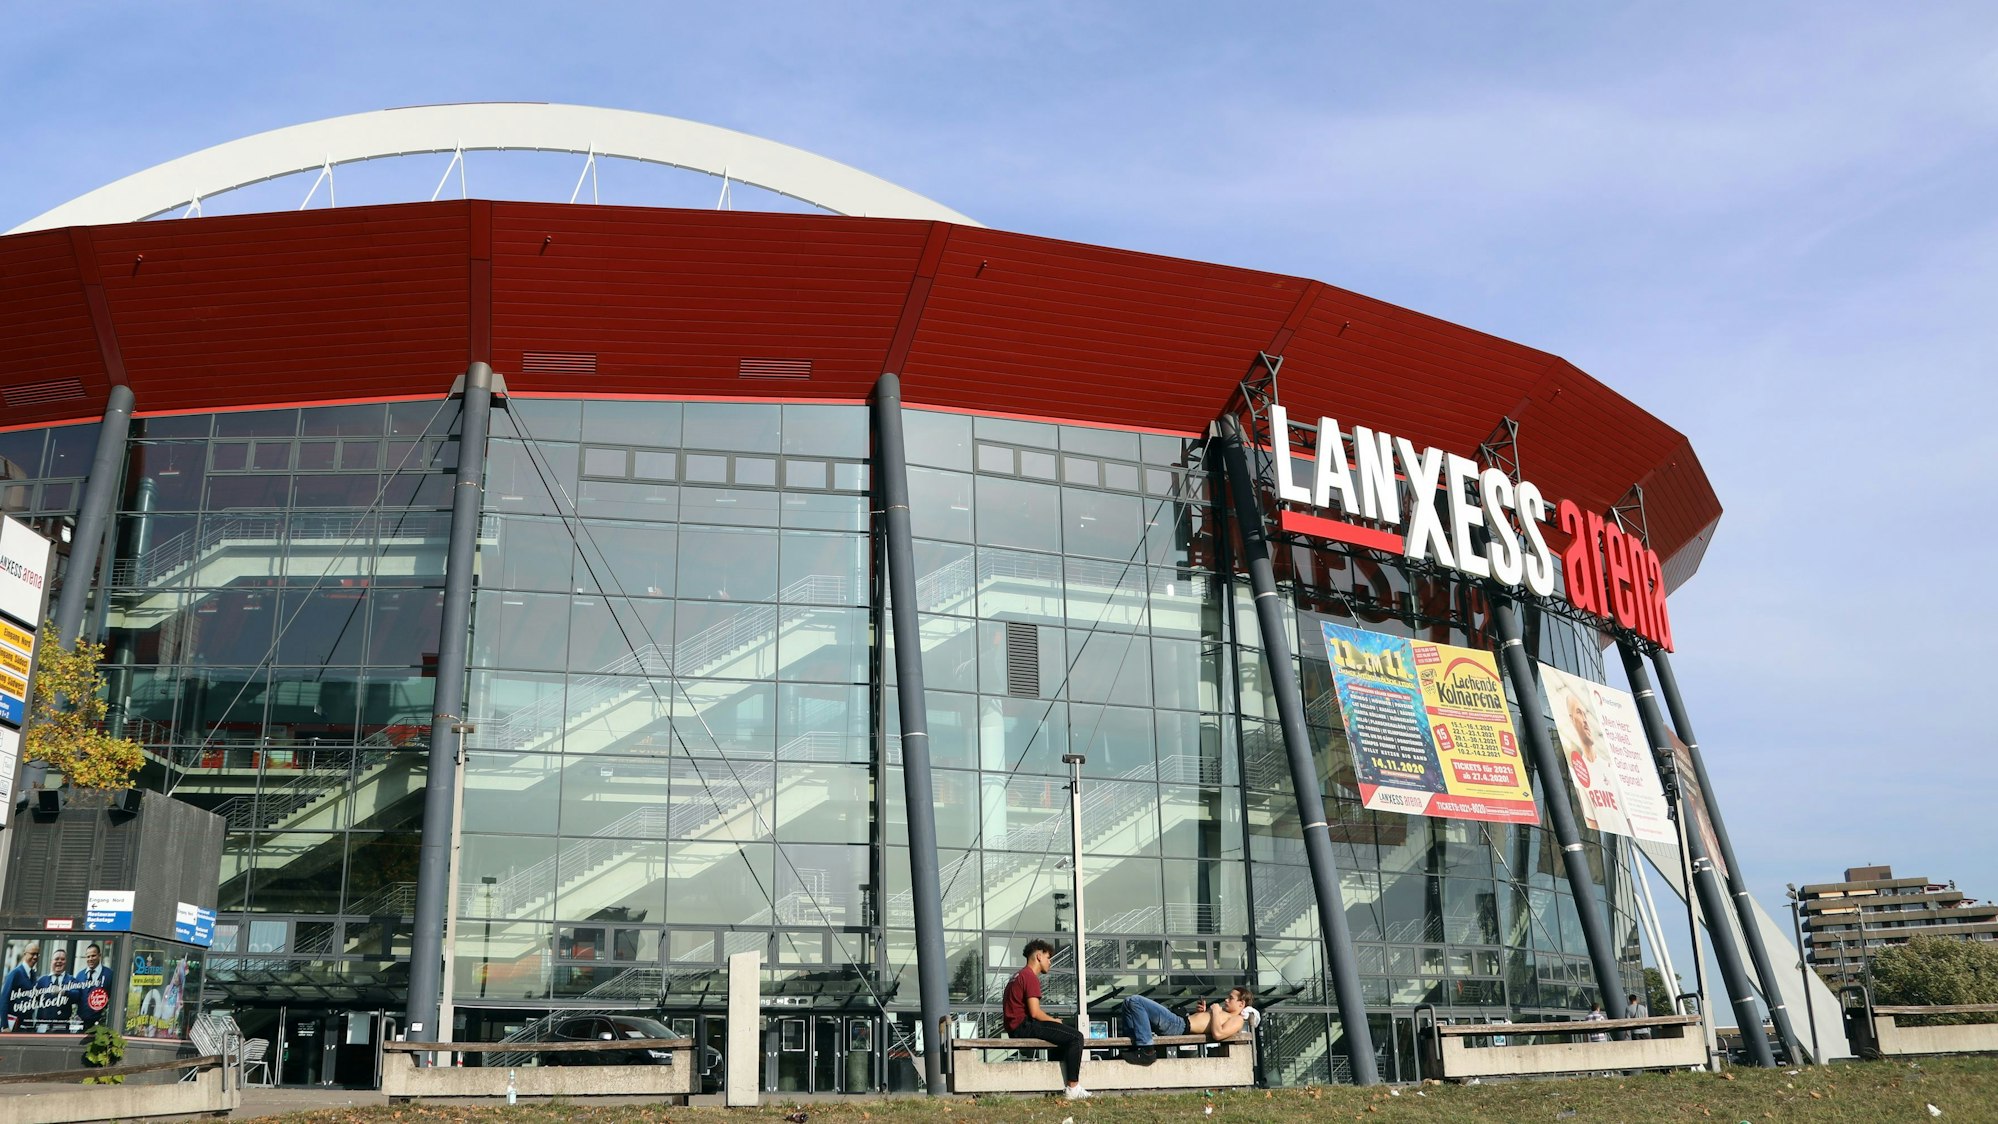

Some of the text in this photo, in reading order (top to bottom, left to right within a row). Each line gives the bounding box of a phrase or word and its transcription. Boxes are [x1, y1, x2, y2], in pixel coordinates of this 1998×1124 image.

[1269, 404, 1554, 597] LANXESS
[1556, 499, 1674, 653] arena
[0, 555, 42, 589] ANXESS arena
[4, 628, 30, 648] Eingang Nord
[1453, 672, 1497, 692] Lachende
[1436, 682, 1502, 709] Kölnarena
[1436, 728, 1447, 740] 15
[1504, 735, 1510, 745] 5
[1610, 743, 1624, 756] Mein
[1371, 757, 1424, 774] 14.11.2020
[1453, 762, 1514, 774] TICKETS für 2021:
[1614, 758, 1640, 773] Grün und
[1472, 773, 1510, 783] 27.4.2020!
[1378, 792, 1423, 808] LANXESS arena
[1589, 790, 1617, 810] REWE
[10, 983, 57, 1000] Lebensfreude
